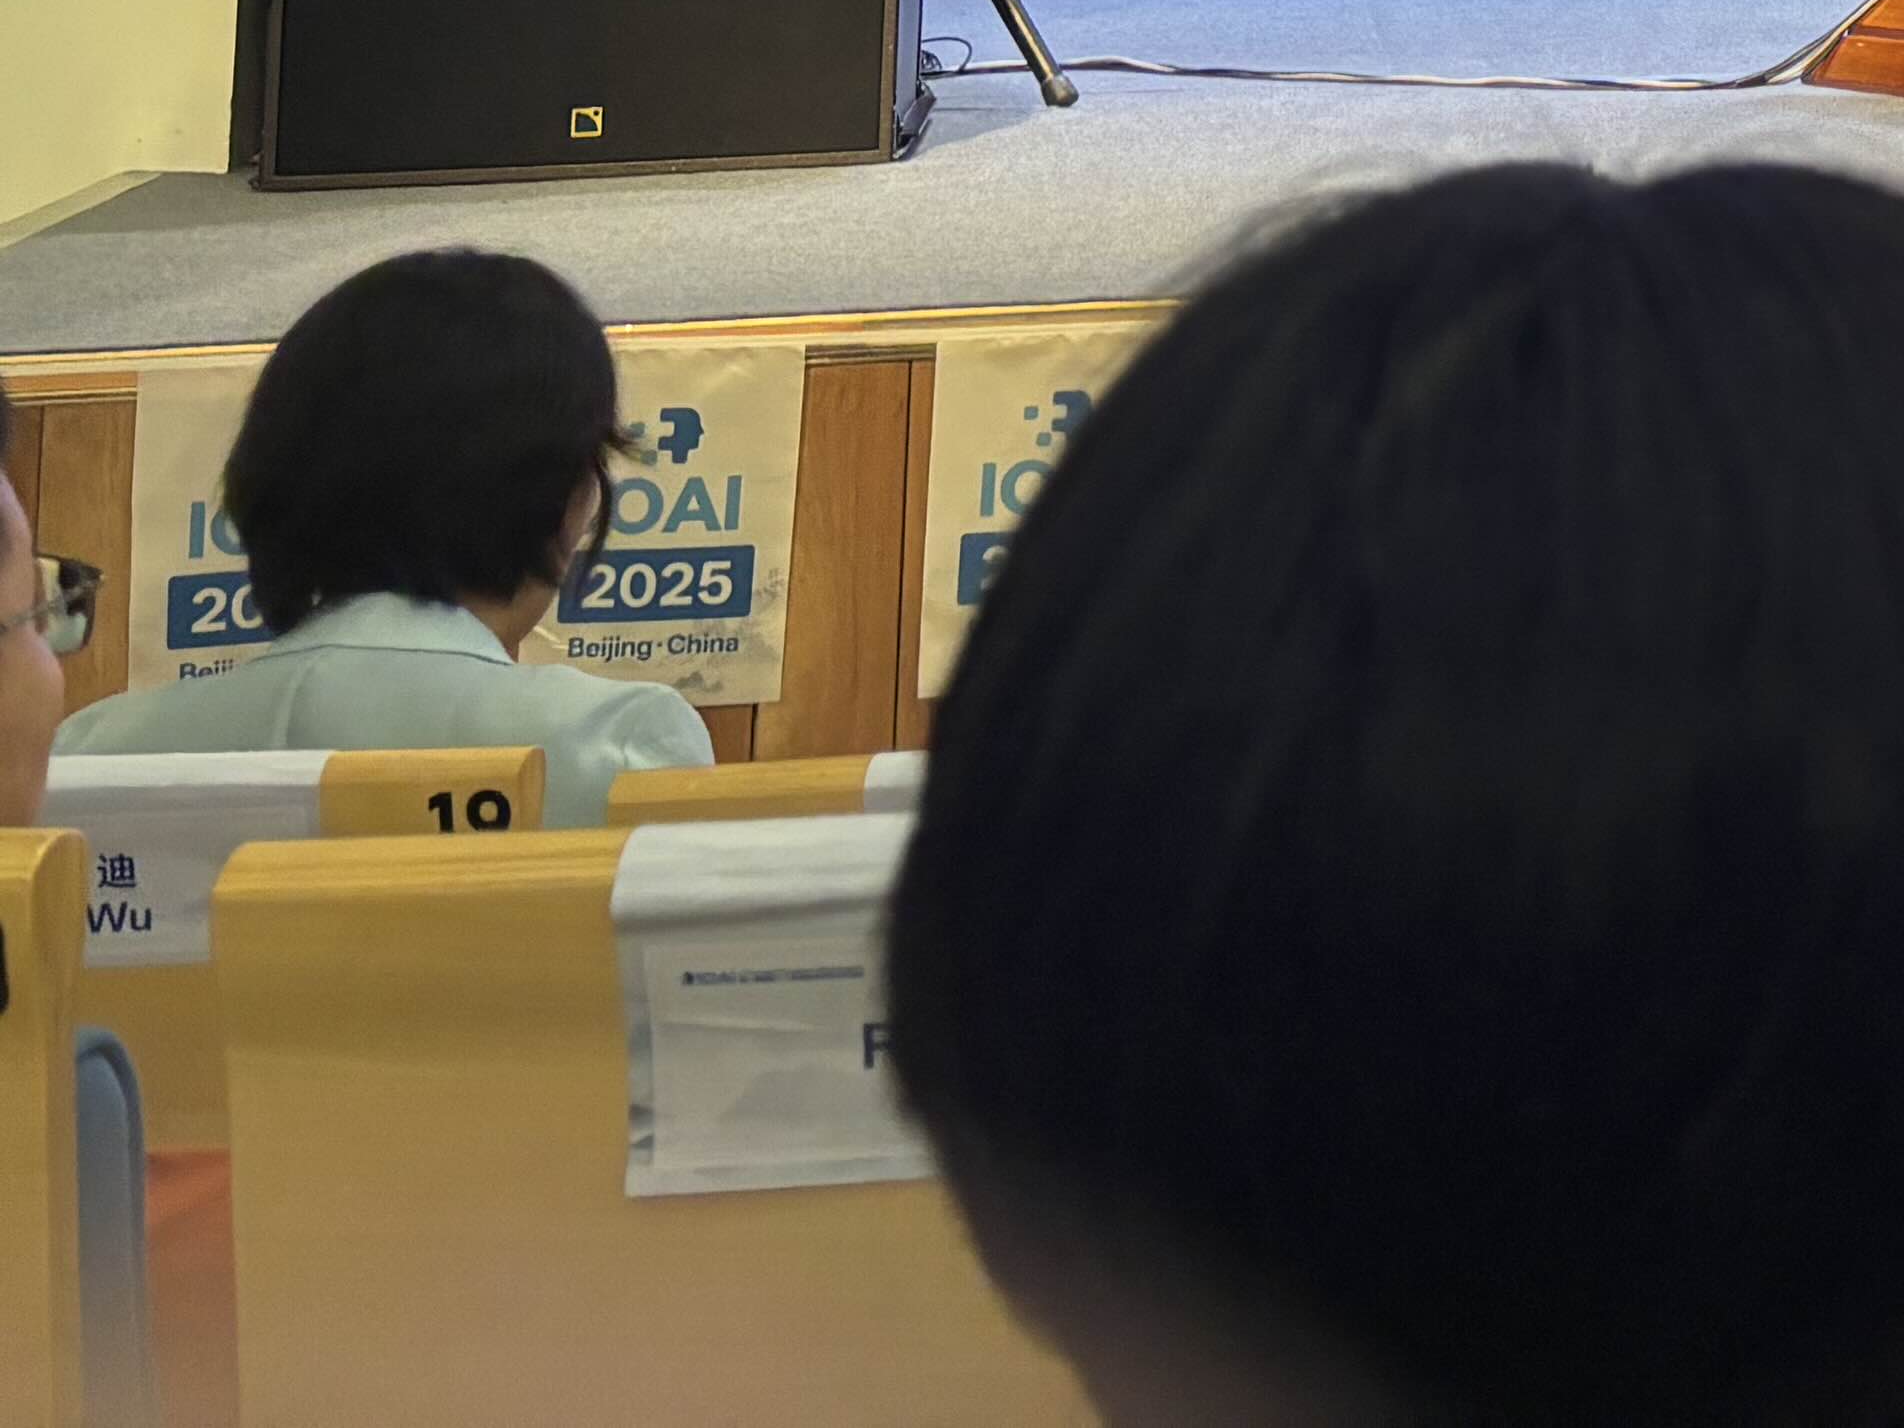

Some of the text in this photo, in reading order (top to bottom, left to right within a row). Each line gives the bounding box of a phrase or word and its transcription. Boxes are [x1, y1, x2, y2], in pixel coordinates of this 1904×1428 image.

[581, 560, 733, 609] 2025
[97, 853, 137, 890] 迪
[87, 902, 152, 934] Wu
